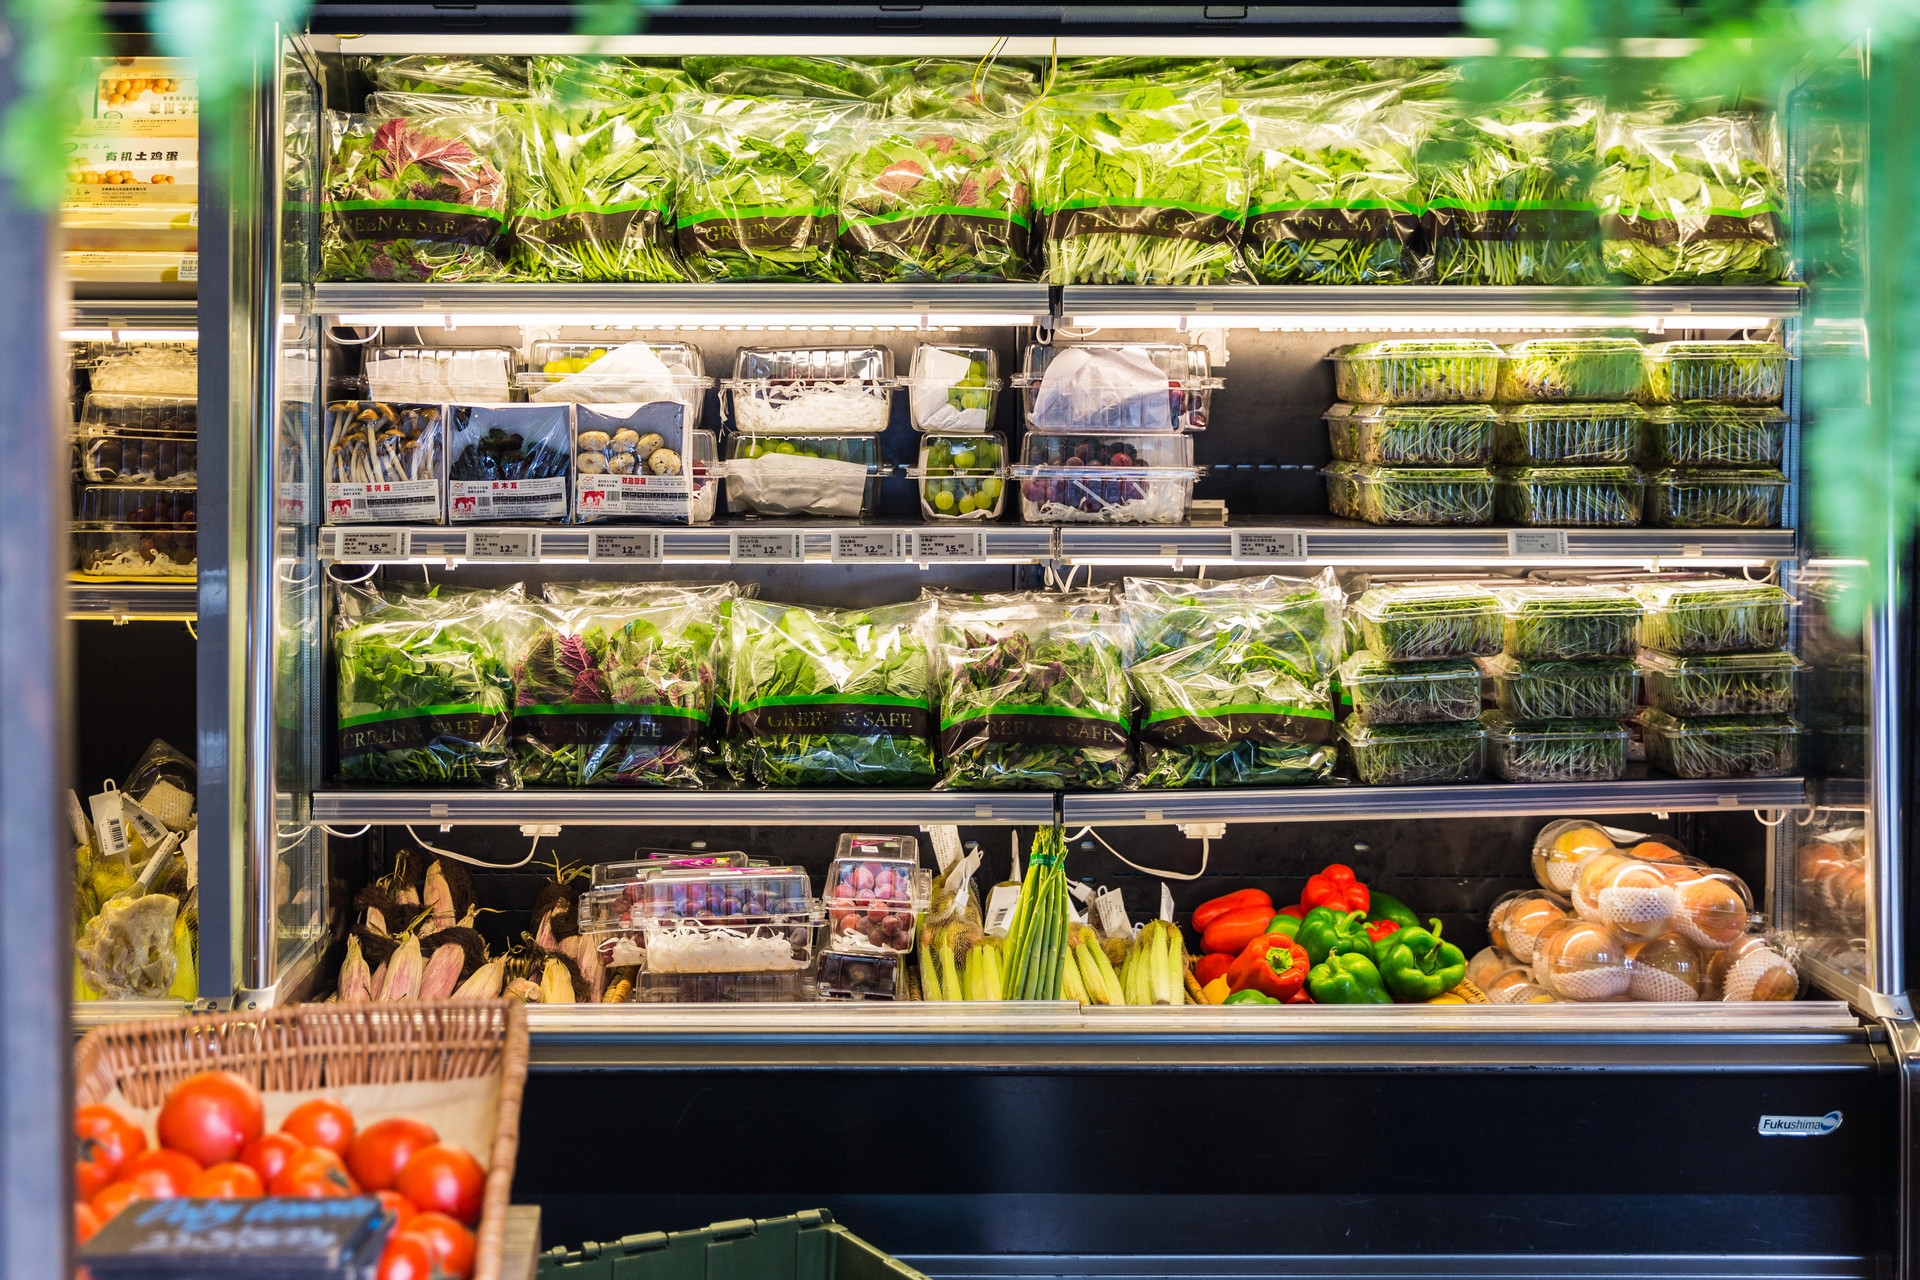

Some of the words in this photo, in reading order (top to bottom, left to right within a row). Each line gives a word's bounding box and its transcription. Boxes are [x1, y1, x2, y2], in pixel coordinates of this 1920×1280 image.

[105, 150, 180, 162] 有机土鸡蛋
[397, 217, 411, 232] &
[1155, 212, 1170, 231] &
[1327, 217, 1342, 231] &
[365, 483, 391, 493] 茶树菇
[492, 481, 518, 490] 黑木耳
[368, 542, 388, 551] 15.00
[499, 544, 519, 553] 12.00
[622, 545, 641, 554] 12.00
[763, 545, 783, 554] 12.00
[865, 544, 884, 553] 12.00
[946, 544, 965, 553] 15.00
[1265, 544, 1285, 553] 12.00
[843, 711, 857, 727] &
[863, 710, 913, 728] SAFE
[984, 720, 1041, 737] REEN
[1066, 722, 1115, 743] SAFE
[1238, 719, 1252, 734] &
[1763, 1119, 1821, 1130] Fukushima
